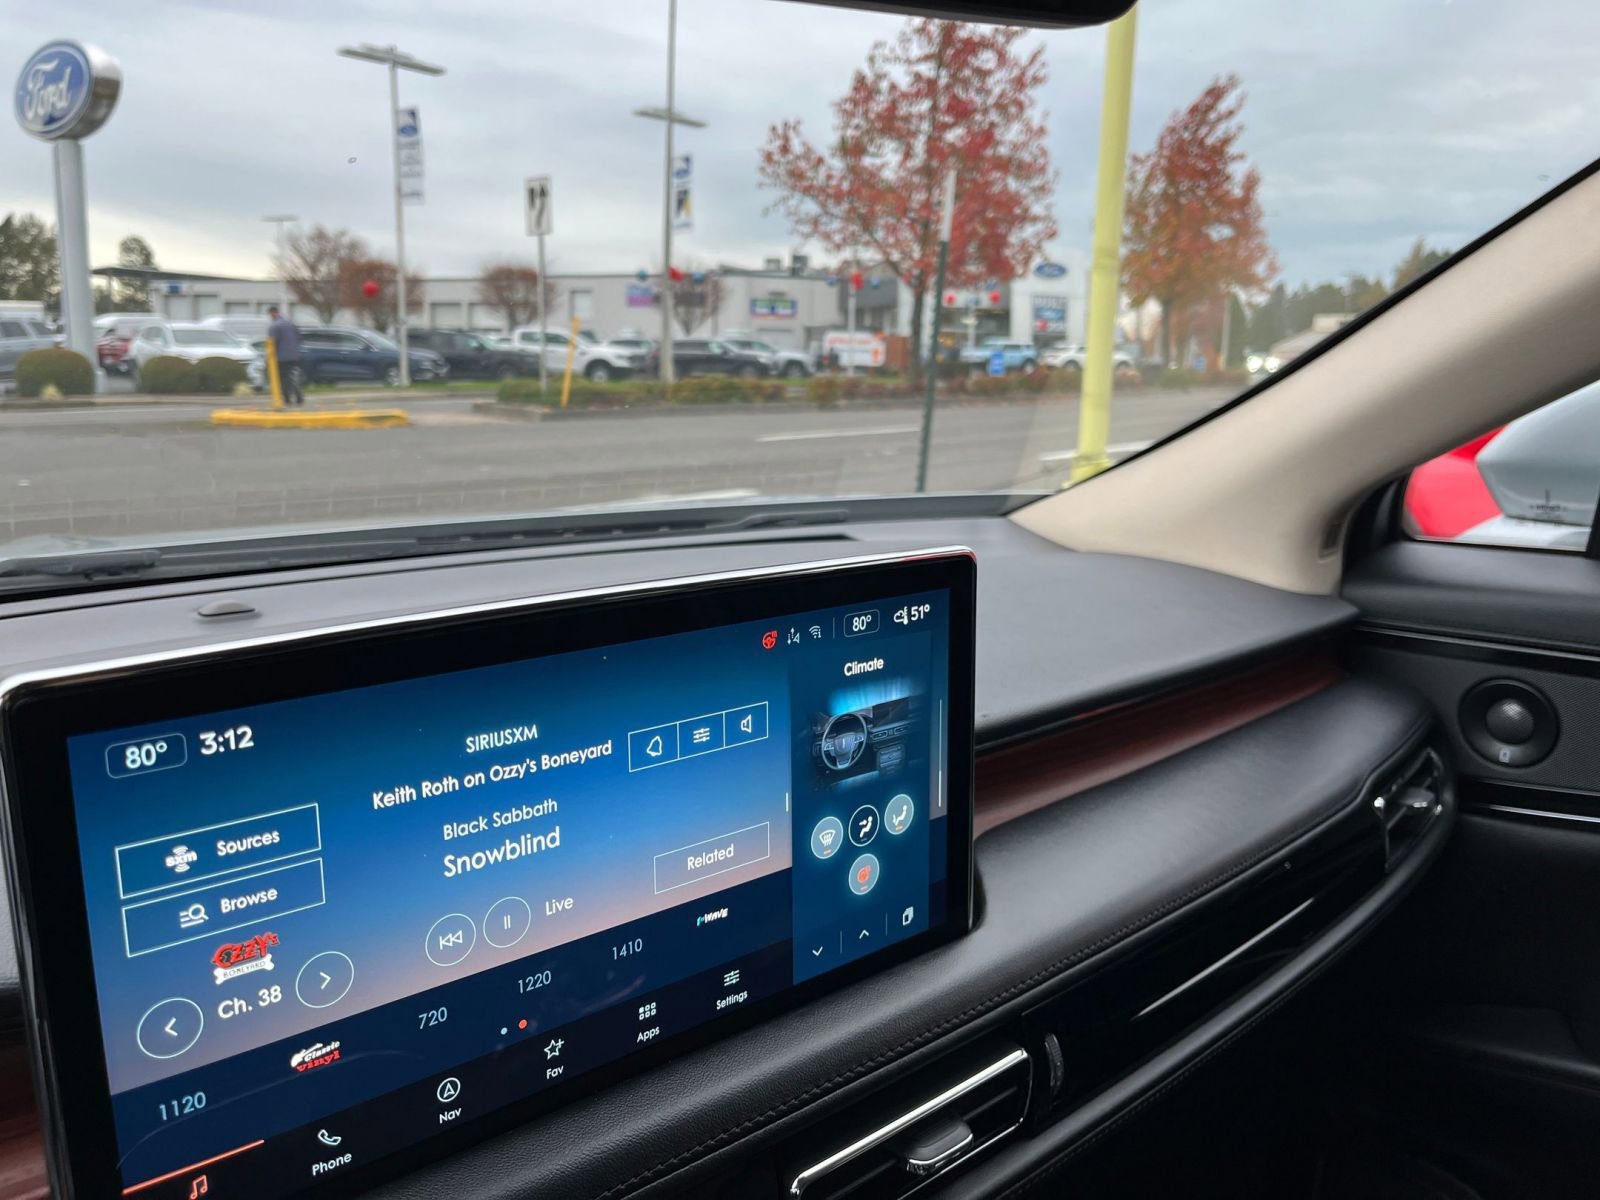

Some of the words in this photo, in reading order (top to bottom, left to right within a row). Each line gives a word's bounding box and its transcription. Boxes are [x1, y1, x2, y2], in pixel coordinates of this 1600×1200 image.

[23, 58, 72, 120] Ford
[844, 657, 884, 676] Climate
[199, 725, 254, 755] 3:12
[466, 724, 538, 753] SIRIUSXM
[372, 785, 417, 810] Keith
[421, 776, 459, 799] Roth
[464, 770, 485, 788] on
[490, 758, 537, 780] Ozzy's
[541, 740, 612, 770] Boneyard
[443, 816, 489, 841] Black
[492, 798, 558, 827] Sabbath
[216, 830, 280, 856] Sources
[443, 826, 561, 878] Snowblind
[687, 843, 734, 871] Related
[220, 888, 278, 914] Browse
[546, 897, 574, 917] Live
[612, 938, 643, 961] 1410
[517, 970, 552, 994] 1220
[218, 998, 252, 1019] Ch.
[258, 985, 283, 1007] 38
[716, 990, 748, 1010] Settings
[418, 1006, 448, 1030] 720
[637, 1026, 660, 1044] Apps
[546, 1064, 564, 1080] Fav
[159, 1091, 207, 1121] 1120
[439, 1108, 462, 1124] Nav
[312, 1152, 352, 1176] Phone
